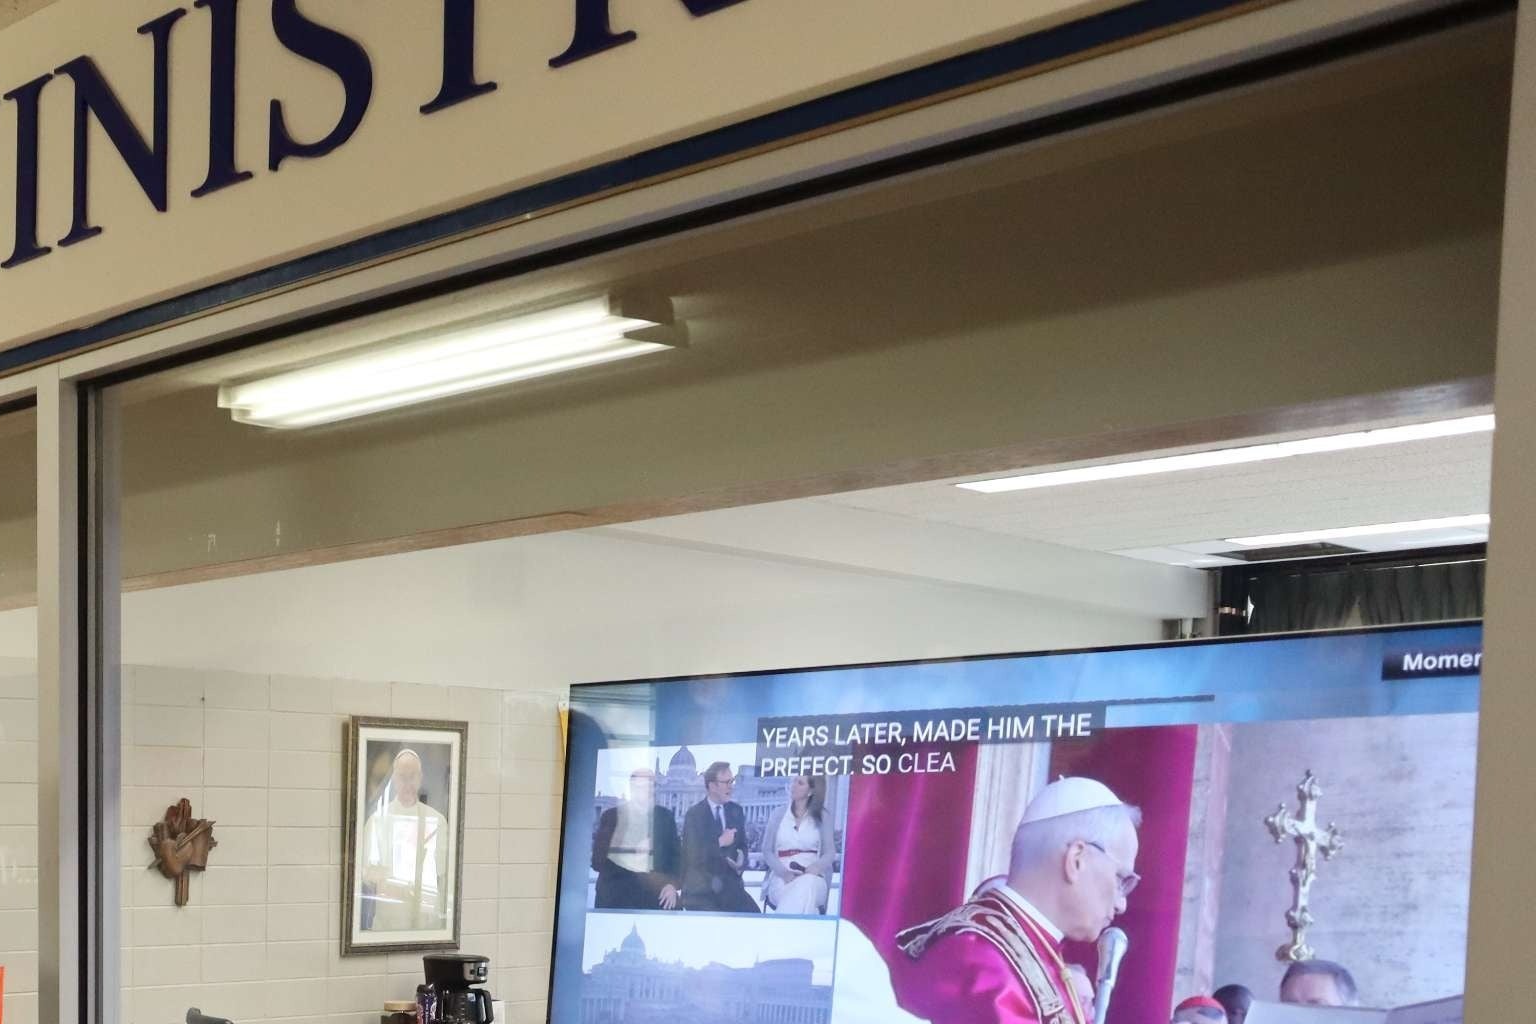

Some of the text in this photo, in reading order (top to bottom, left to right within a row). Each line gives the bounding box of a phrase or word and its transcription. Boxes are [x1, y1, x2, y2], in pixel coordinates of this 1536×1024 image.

[762, 712, 1092, 749] YEARS LATER, MADE HIM THE
[862, 753, 891, 776] SO
[897, 751, 957, 774] CLEA
